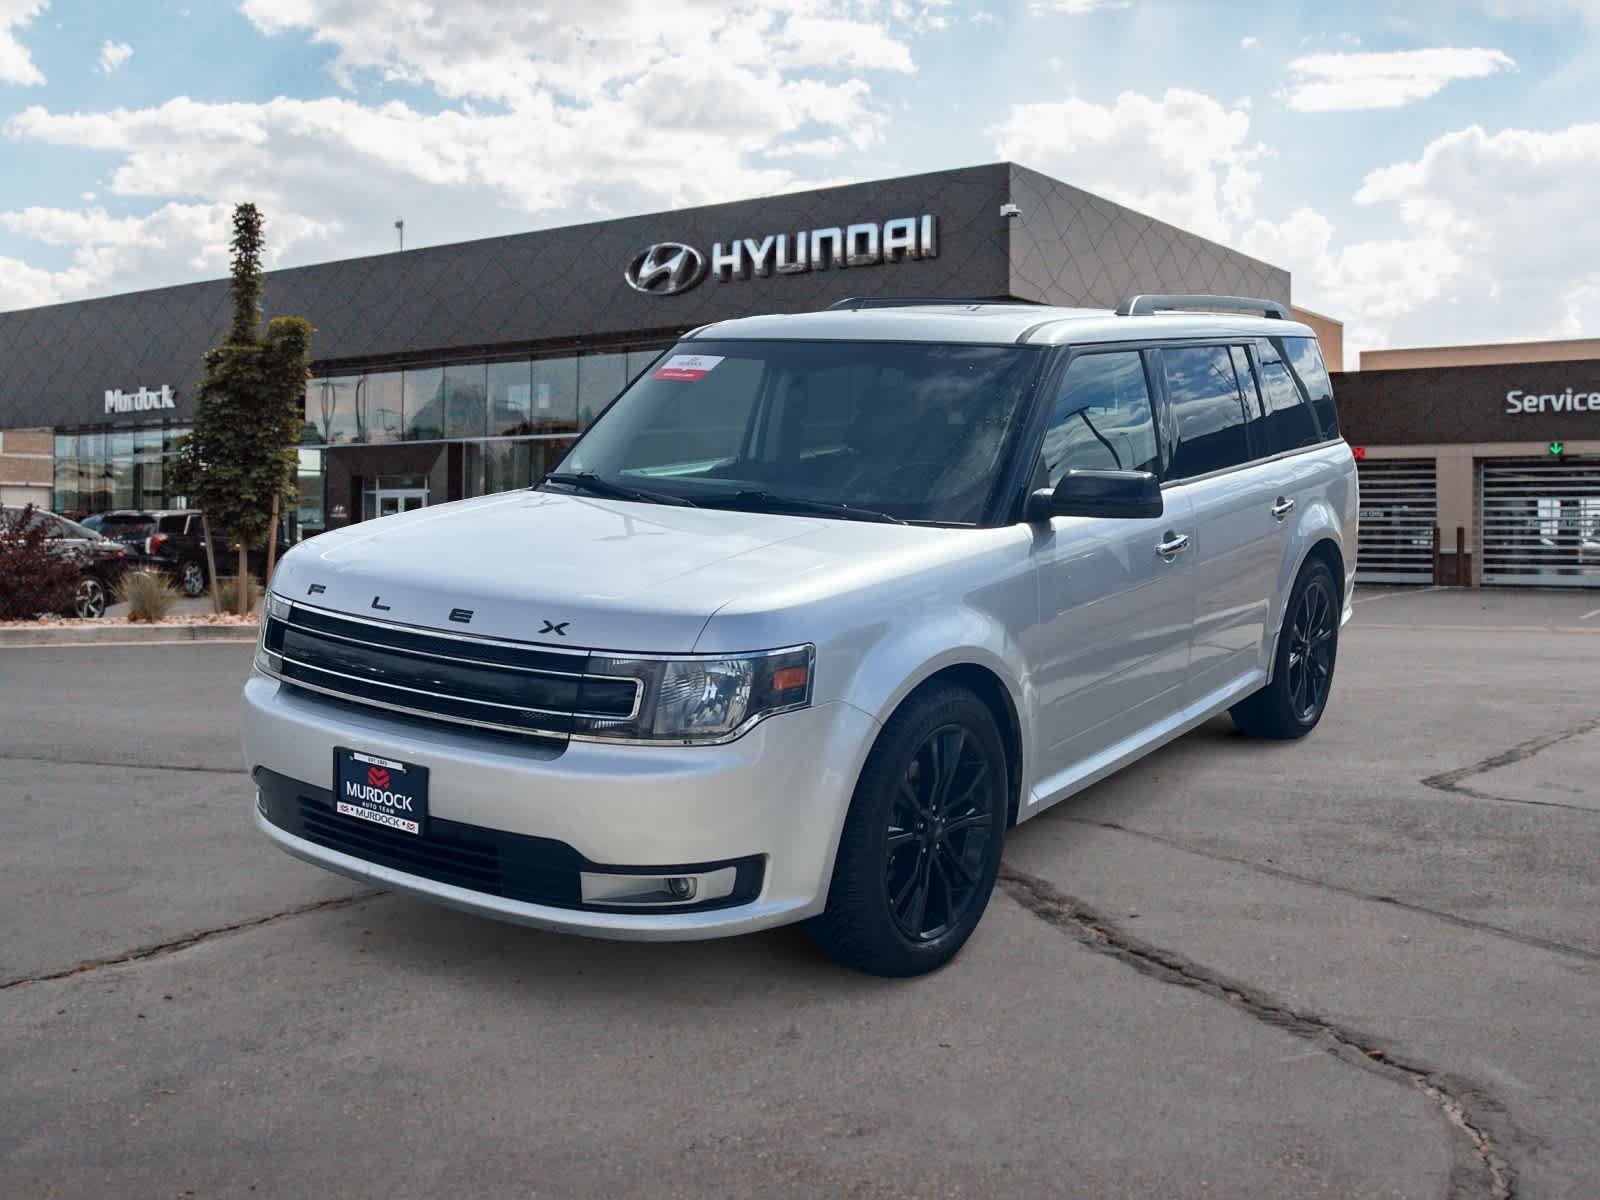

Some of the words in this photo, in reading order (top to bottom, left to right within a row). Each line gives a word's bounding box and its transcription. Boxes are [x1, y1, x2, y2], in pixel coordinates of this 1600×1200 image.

[712, 214, 936, 281] HYUNDAI
[104, 384, 176, 414] Murdock
[1505, 387, 1600, 414] Service
[308, 583, 570, 635] FLEX
[346, 780, 413, 812] MURDOCK
[362, 801, 377, 810] AUTO
[379, 805, 395, 814] TEAM
[355, 807, 400, 827] MURDOCK
